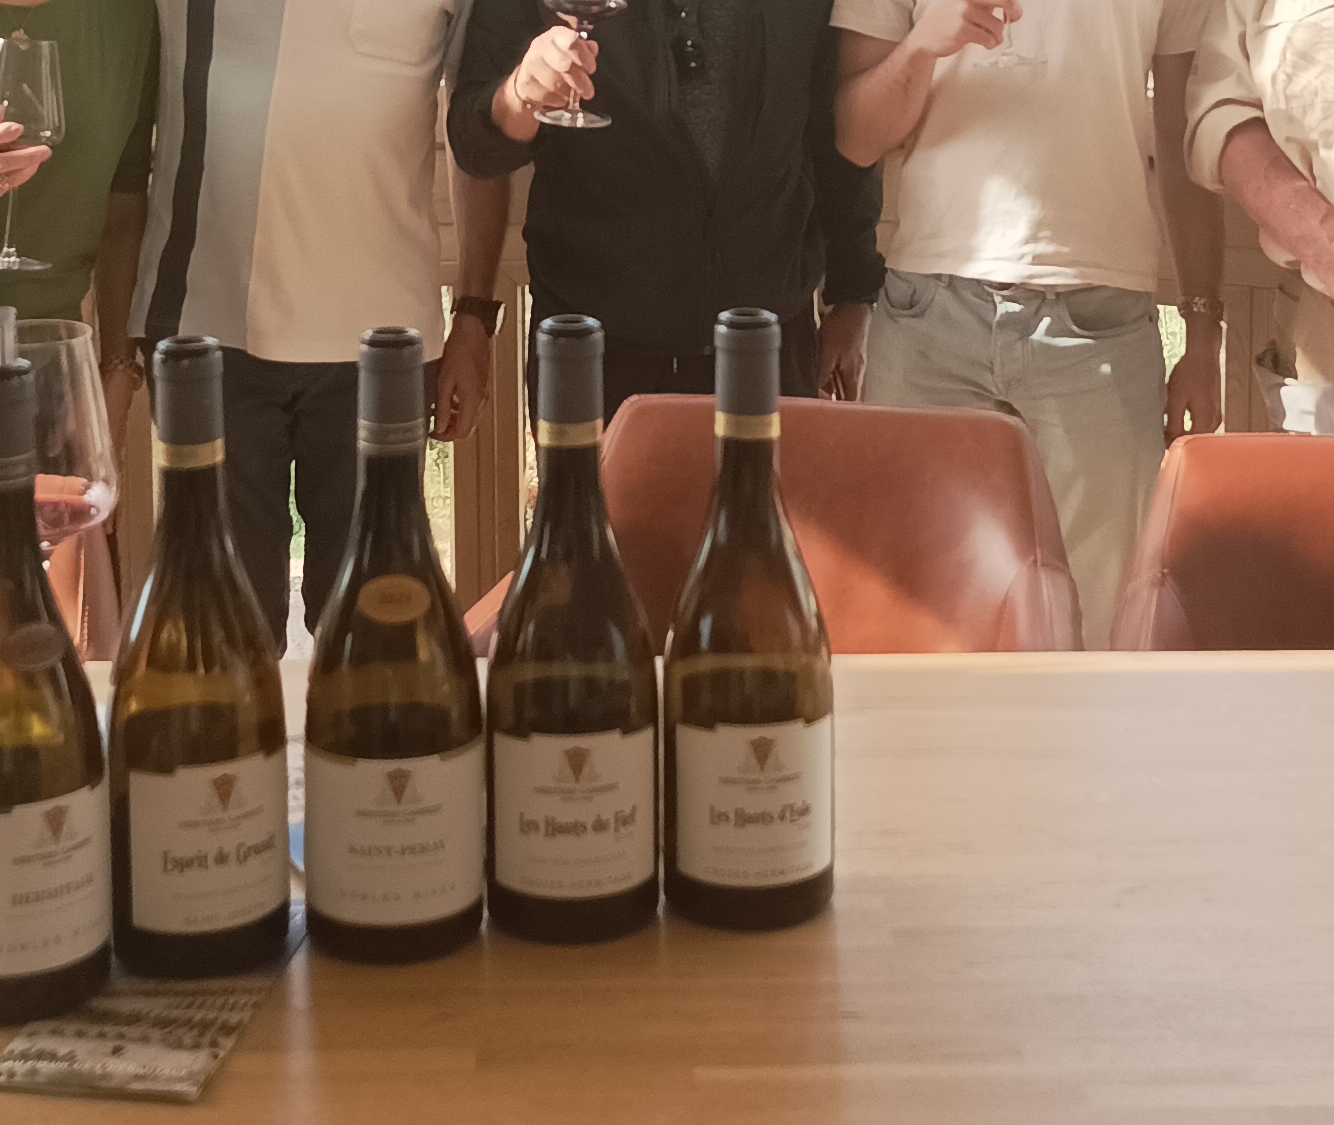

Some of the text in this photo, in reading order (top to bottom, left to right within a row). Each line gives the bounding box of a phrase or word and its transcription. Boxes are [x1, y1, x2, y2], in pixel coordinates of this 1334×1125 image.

[518, 810, 540, 836] Les
[543, 814, 588, 838] Hauts
[591, 812, 611, 832] du
[709, 803, 731, 826] Les
[734, 806, 774, 828] Hauts
[162, 848, 209, 874] Esprit
[213, 845, 231, 865] de
